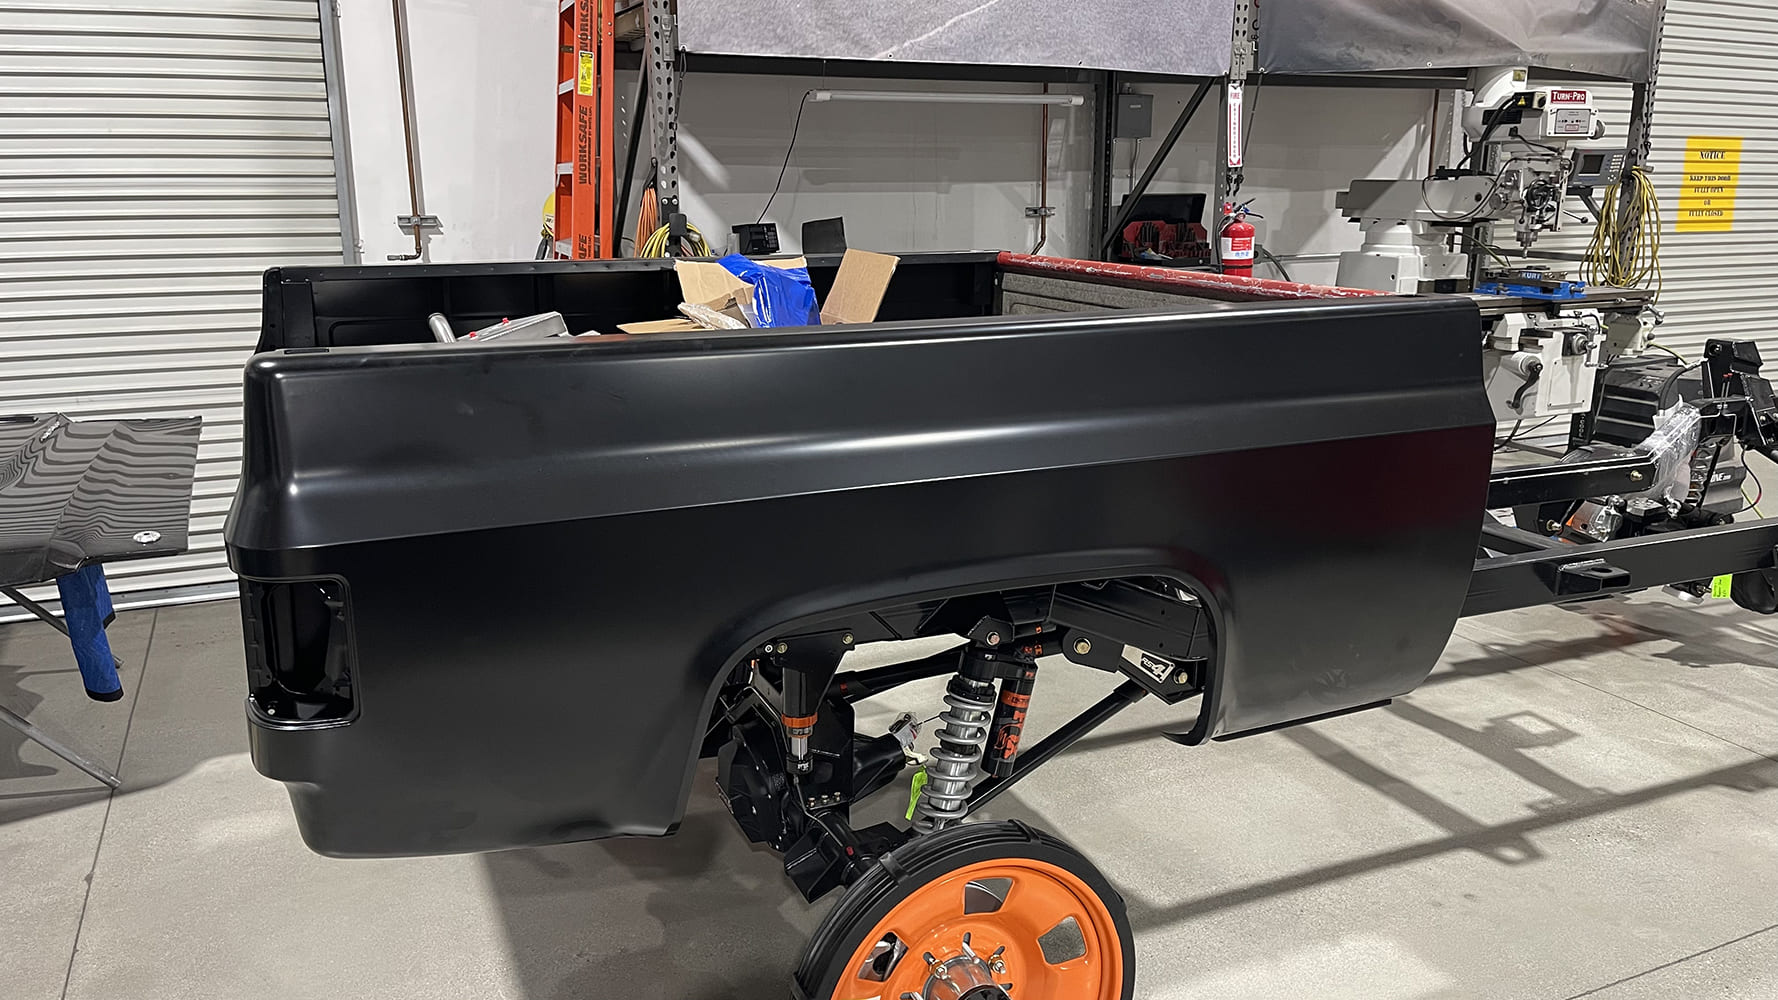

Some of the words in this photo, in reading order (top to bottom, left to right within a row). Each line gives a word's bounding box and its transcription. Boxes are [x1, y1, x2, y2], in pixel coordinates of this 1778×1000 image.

[1552, 91, 1586, 101] TURN-PRO
[579, 105, 587, 185] WORKSAFE
[1699, 150, 1725, 159] NOTICE
[1521, 271, 1541, 280] KURT
